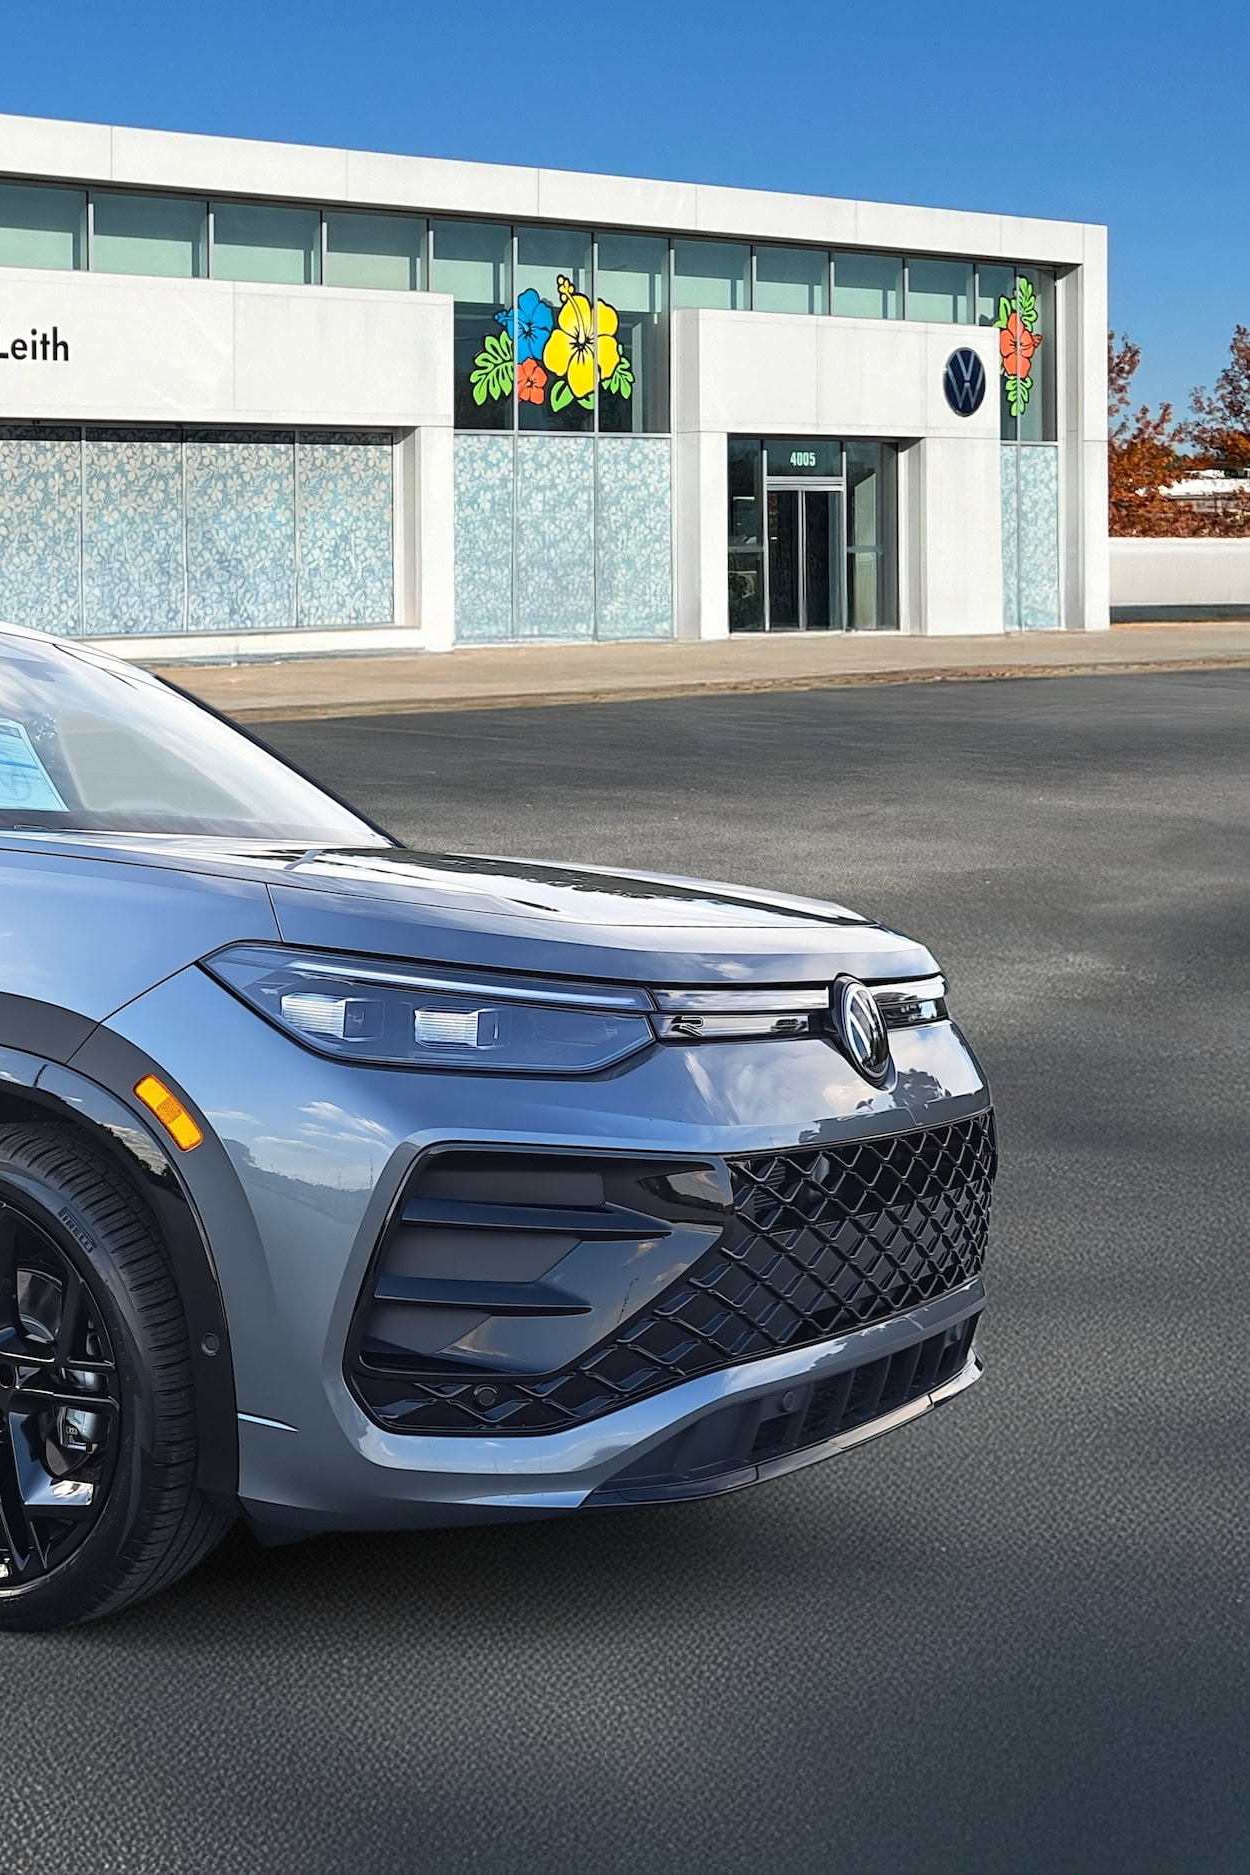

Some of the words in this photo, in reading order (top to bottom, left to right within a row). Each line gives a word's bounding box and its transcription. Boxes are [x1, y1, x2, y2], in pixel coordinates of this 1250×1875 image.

[944, 348, 986, 417] VW
[789, 451, 816, 467] 4005
[671, 1016, 704, 1037] R
[57, 1206, 97, 1254] PIRELLI
